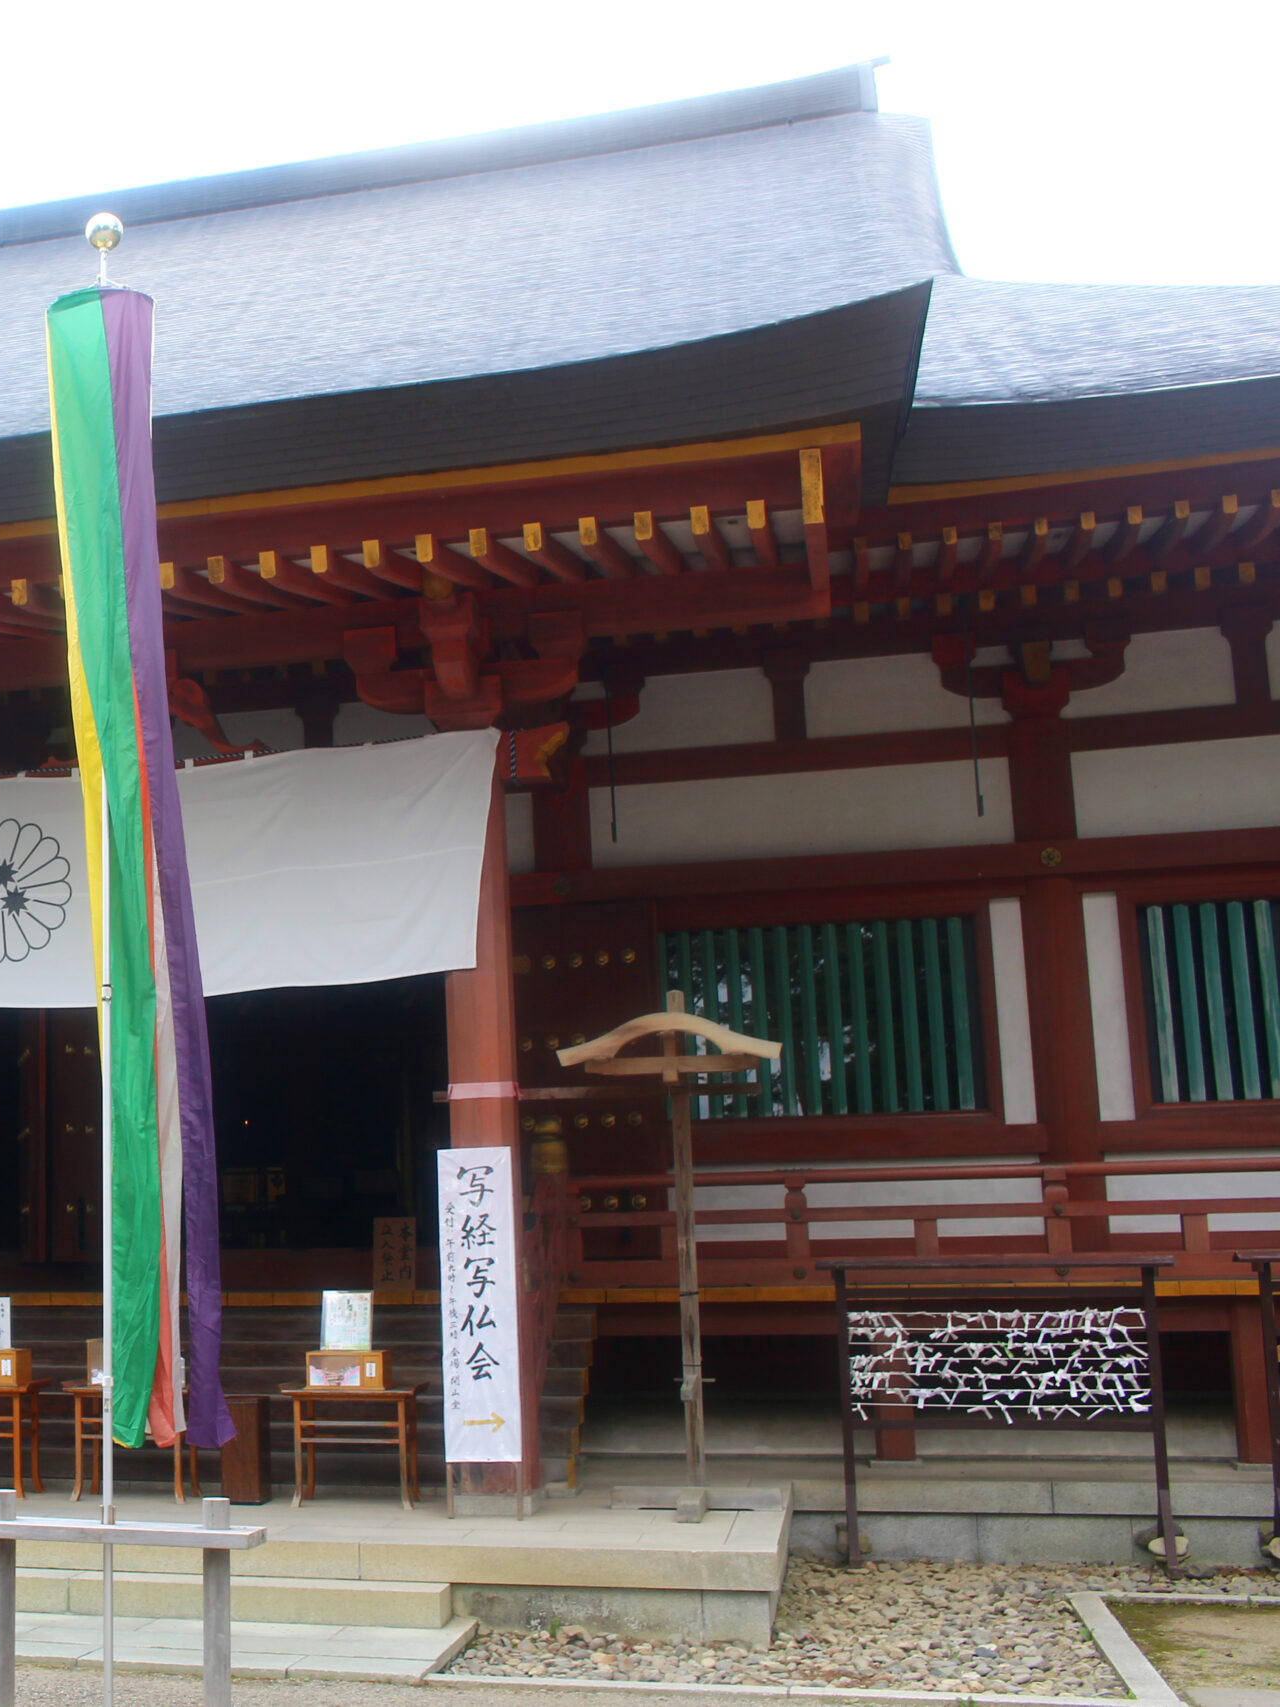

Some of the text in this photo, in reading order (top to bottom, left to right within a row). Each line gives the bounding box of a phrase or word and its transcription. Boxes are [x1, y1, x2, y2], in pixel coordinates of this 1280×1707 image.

[380, 1223, 395, 1282] 立入禁止
[456, 1165, 500, 1381] 写経写仏会
